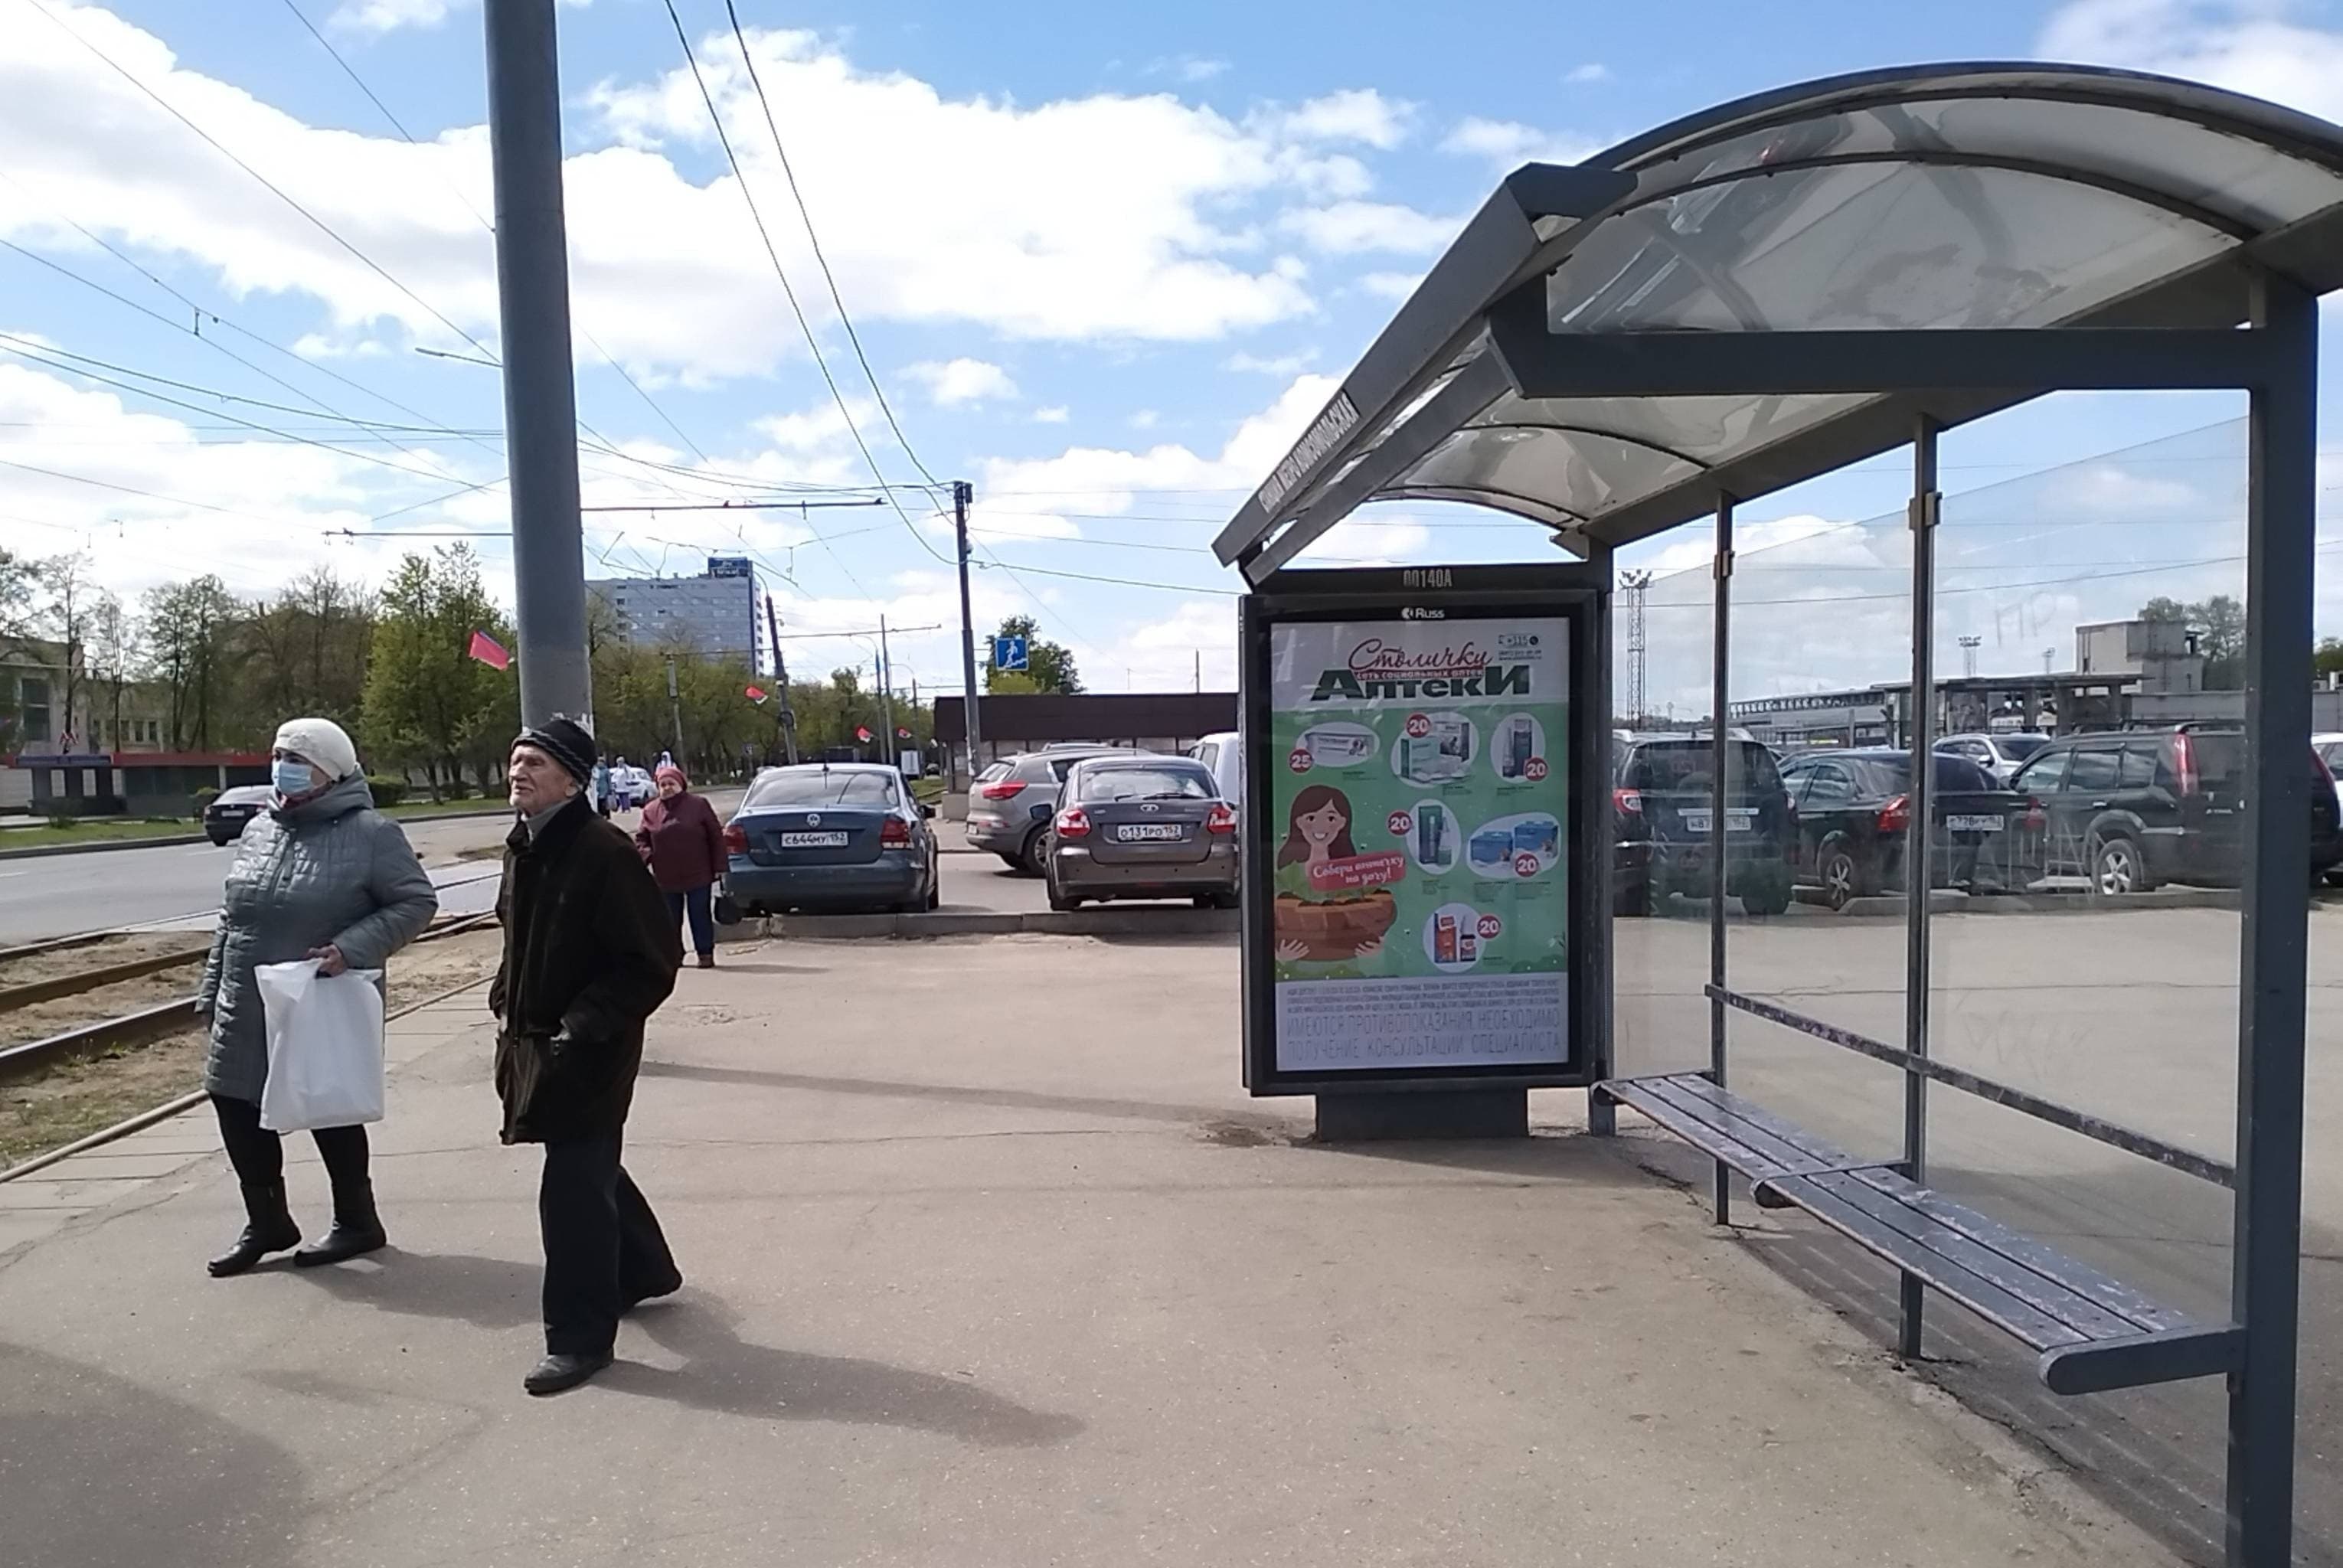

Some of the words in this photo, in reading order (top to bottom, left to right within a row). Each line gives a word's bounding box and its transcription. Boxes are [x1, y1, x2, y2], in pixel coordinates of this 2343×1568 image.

[1415, 607, 1446, 619] Russ
[1348, 639, 1493, 670] Столички
[1409, 719, 1428, 733] 20
[1291, 755, 1311, 768] 25
[1527, 763, 1546, 776] 20
[1389, 816, 1410, 830] 20
[1312, 864, 1354, 878] Собери
[1517, 858, 1537, 872] 20
[1345, 874, 1360, 884] на
[1479, 920, 1498, 933] 20
